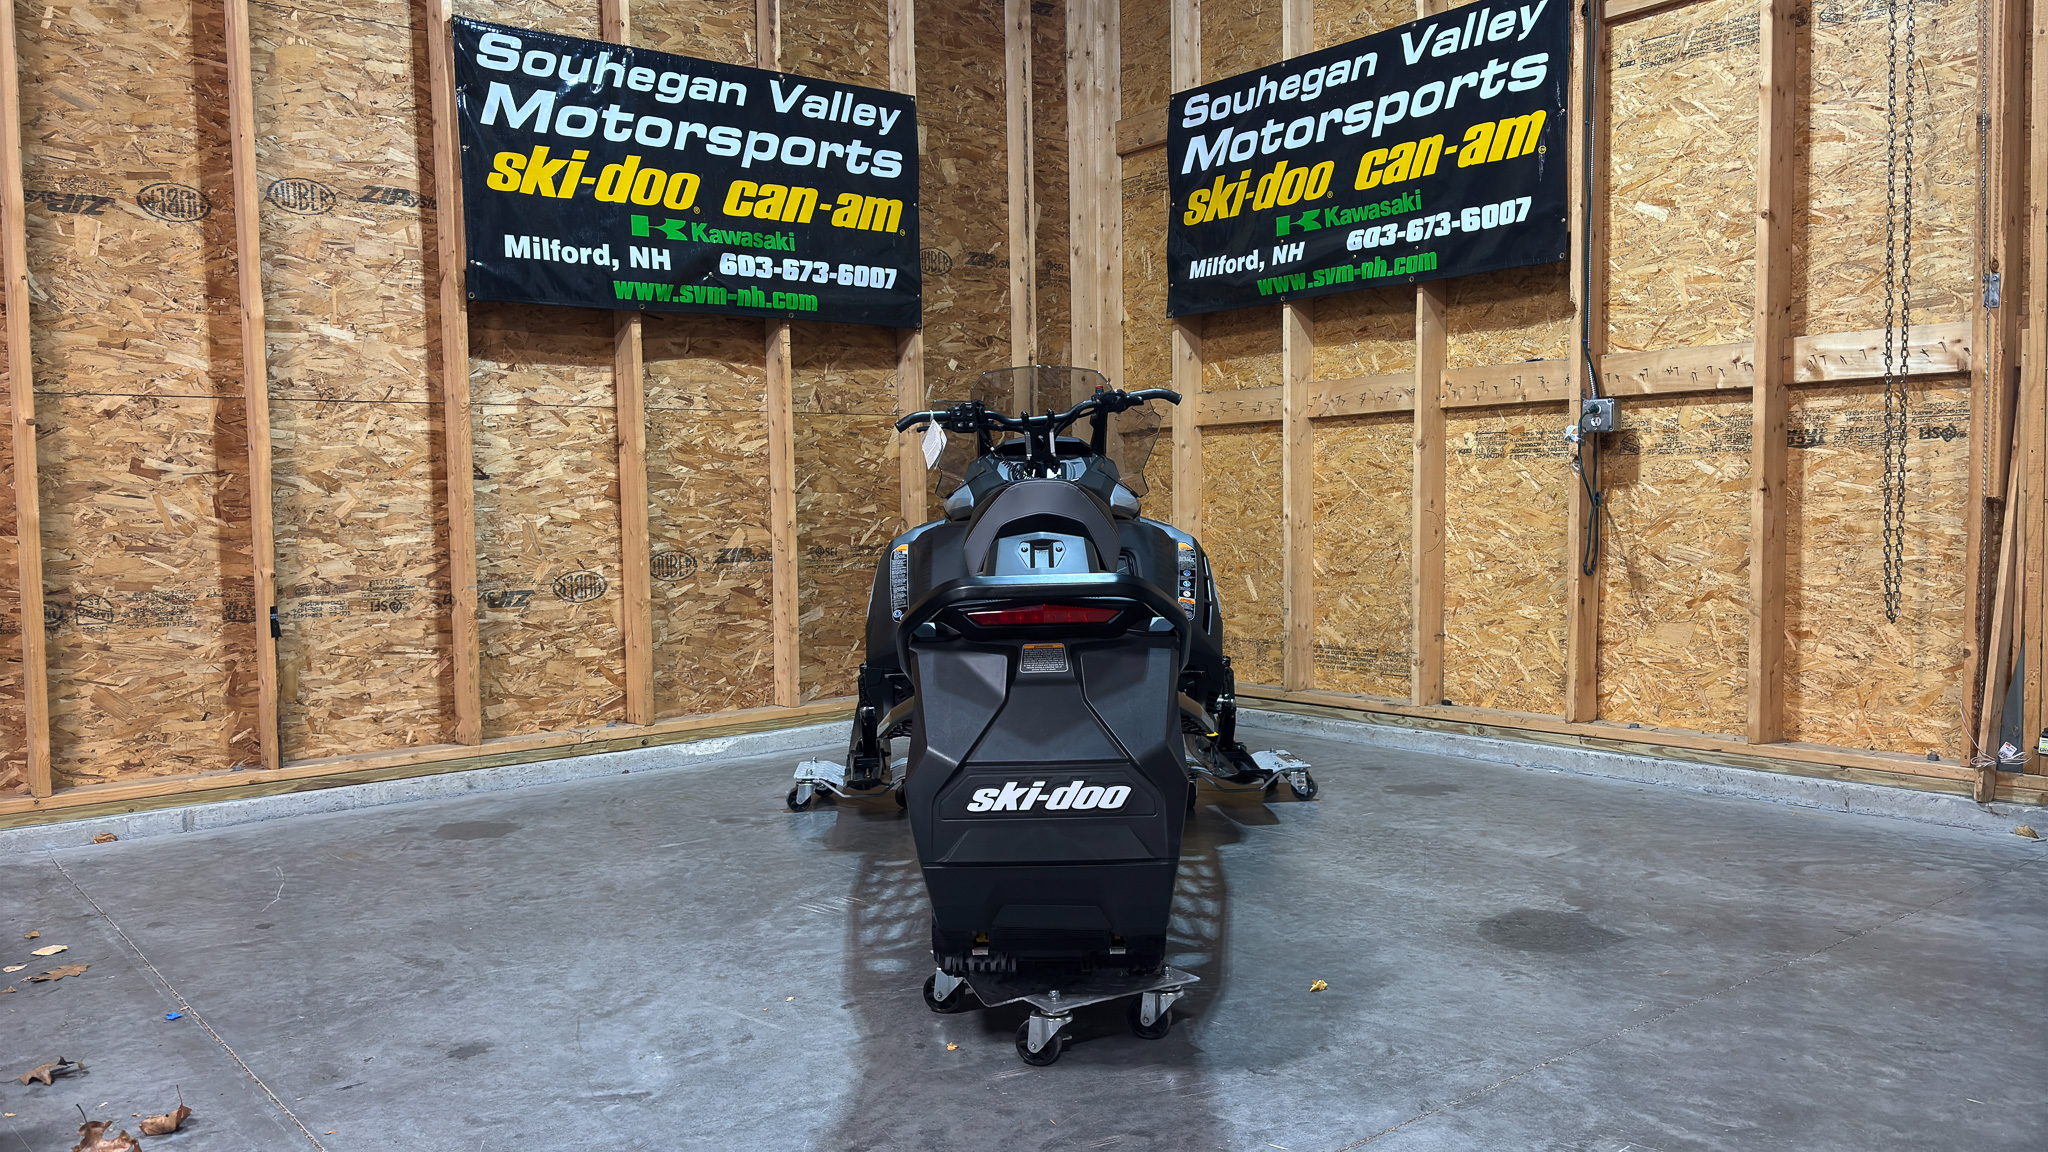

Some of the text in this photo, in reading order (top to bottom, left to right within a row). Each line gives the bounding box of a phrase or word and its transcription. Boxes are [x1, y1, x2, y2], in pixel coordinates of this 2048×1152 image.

[477, 31, 901, 135] Souhegan Valley
[1183, 0, 1548, 128] Souhegan Valley
[480, 81, 902, 178] Motorsports
[1182, 53, 1549, 174] Motorsports
[487, 145, 903, 232] ski-doo can-am
[1184, 160, 1334, 225] ski-doo
[1355, 110, 1546, 190] can-am
[274, 180, 330, 212] HUBER
[1325, 189, 1421, 227] Kawasaki
[505, 235, 897, 289] Milford, NH 603-673-6007
[691, 222, 795, 251] Kawasaki
[1189, 196, 1531, 279] Milford, NH 603-673-6007
[613, 281, 818, 311] www.svm-nh.com
[1257, 252, 1437, 296] www.svm-nh.com
[652, 554, 693, 578] HUBER
[967, 781, 1131, 811] ski-doo
